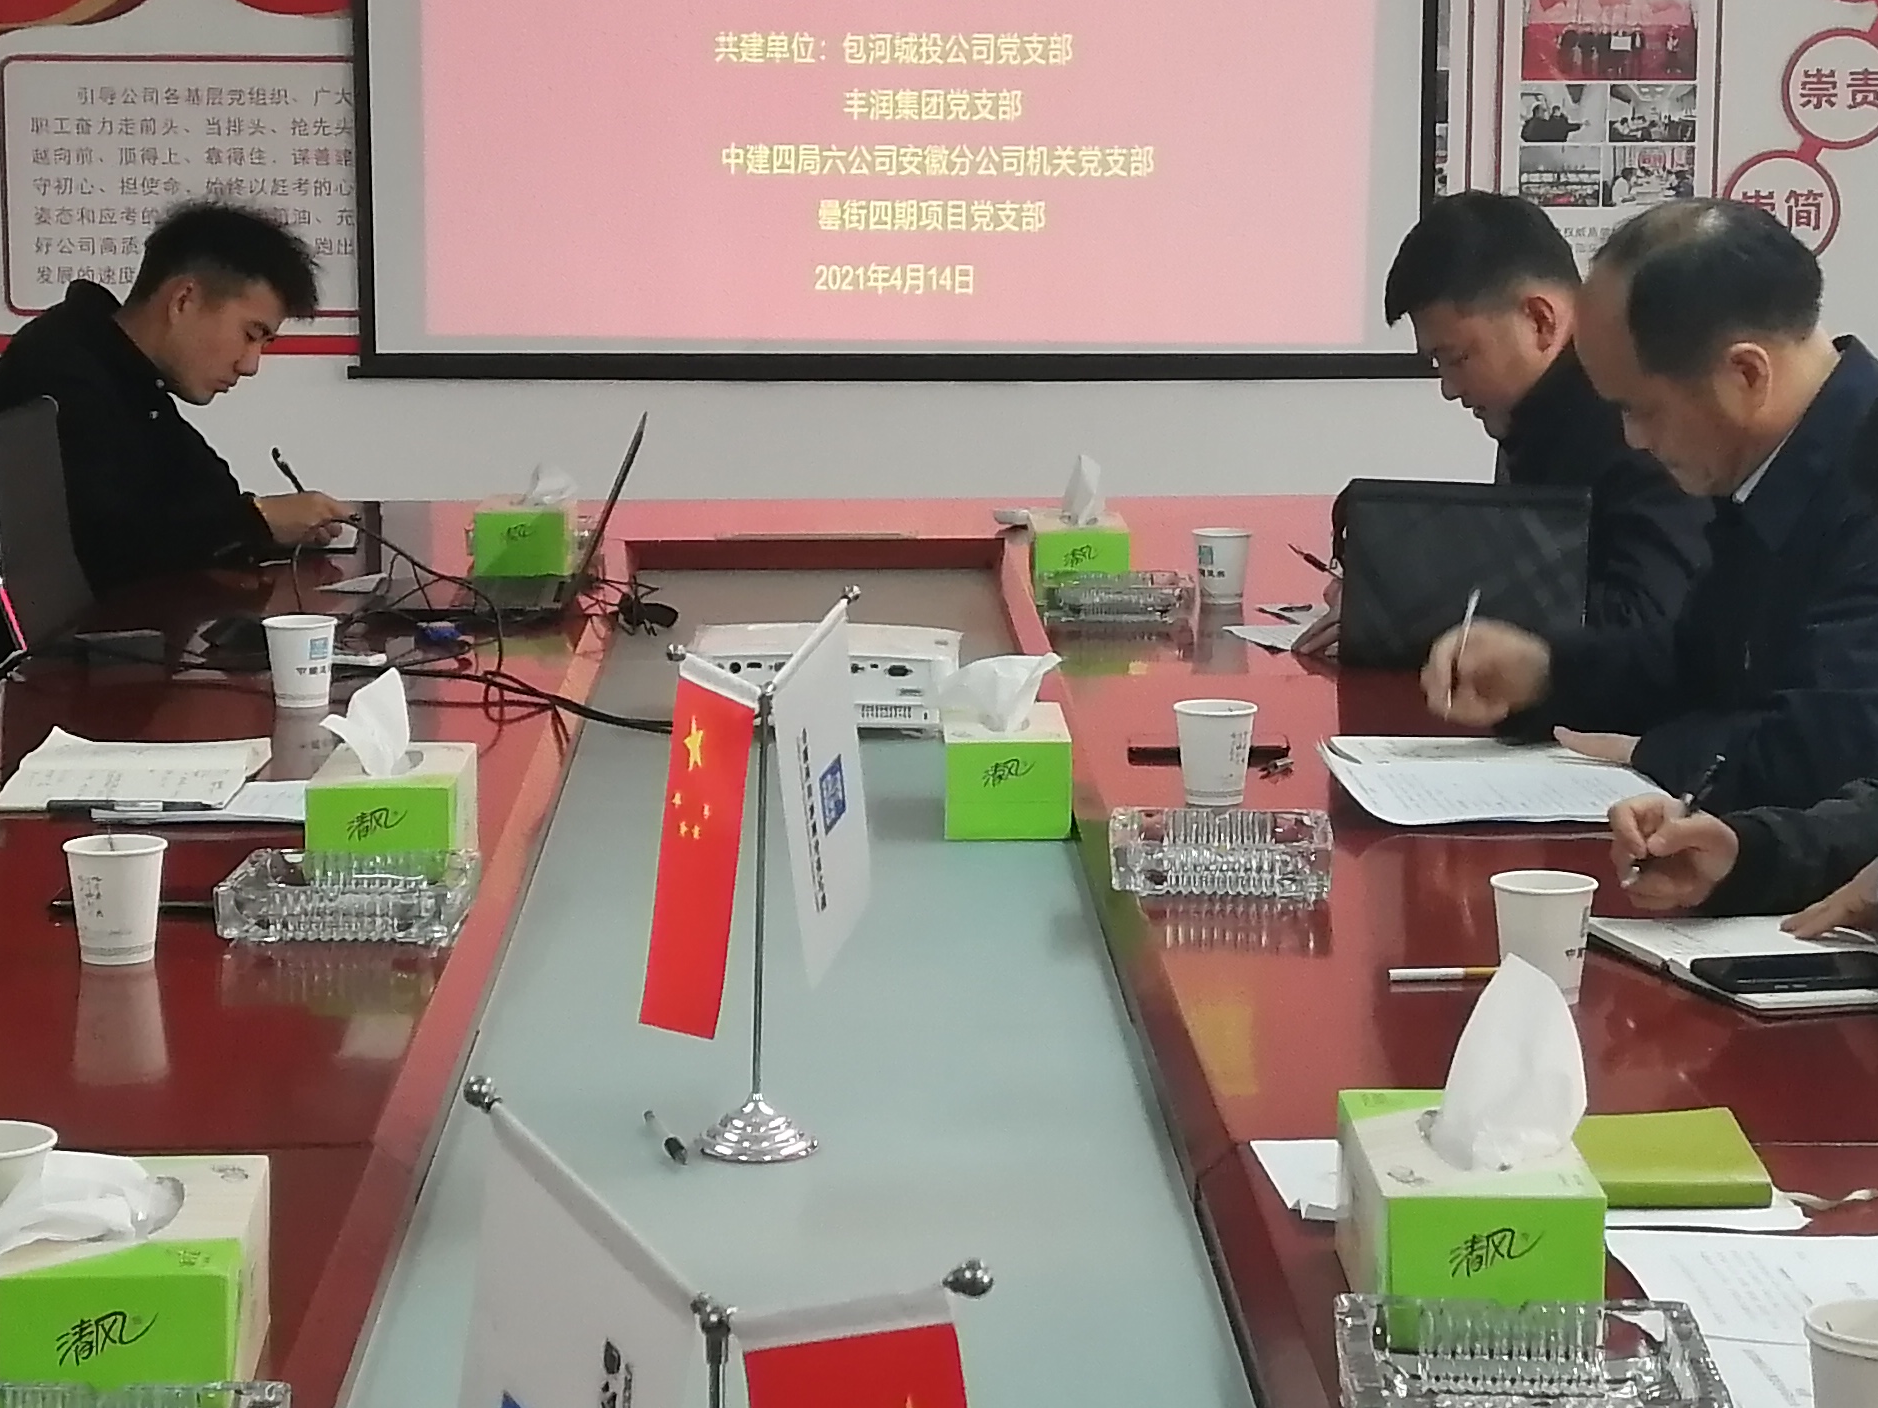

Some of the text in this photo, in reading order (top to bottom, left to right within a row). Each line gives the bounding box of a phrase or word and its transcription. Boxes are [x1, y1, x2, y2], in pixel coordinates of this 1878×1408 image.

[714, 31, 1074, 65] 共建单位：包河城投公司党支部
[842, 88, 1023, 122] 丰润集团党支部
[721, 142, 1156, 178] 中建四局六公司安徽分公司机关党支部
[815, 263, 975, 295] 2021年4月14日
[1063, 544, 1099, 568] 清风
[982, 758, 1037, 788] 清风
[346, 807, 408, 842] 清风
[1449, 1227, 1545, 1278] 清风
[55, 1310, 159, 1367] 清风
